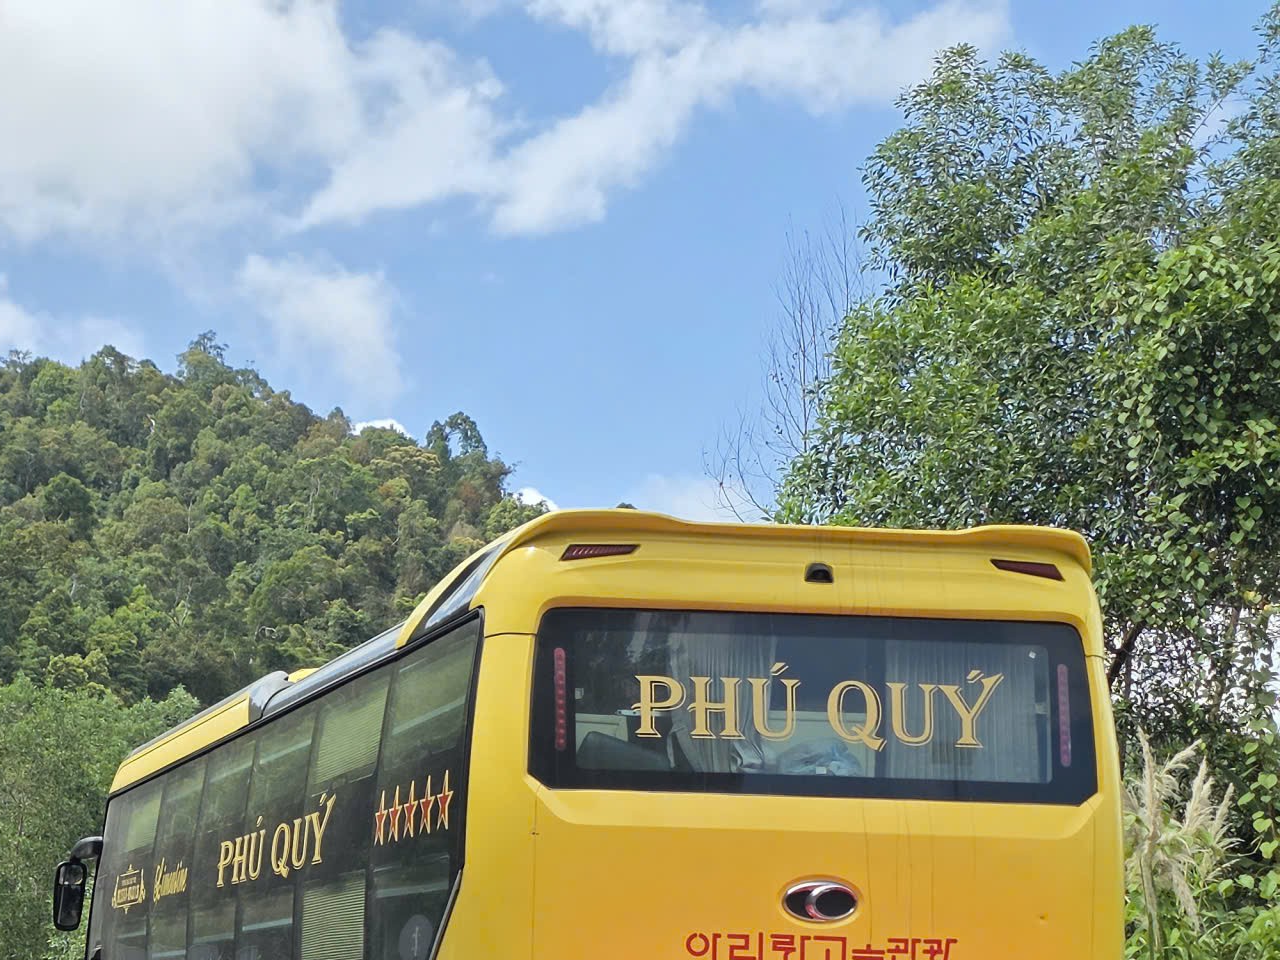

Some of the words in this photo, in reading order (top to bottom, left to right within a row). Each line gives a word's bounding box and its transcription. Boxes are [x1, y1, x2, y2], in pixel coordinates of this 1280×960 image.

[631, 662, 801, 741] PHÚ
[827, 670, 1005, 752] QUÝ
[216, 815, 266, 888] PHÚ
[271, 792, 337, 878] QUÝ
